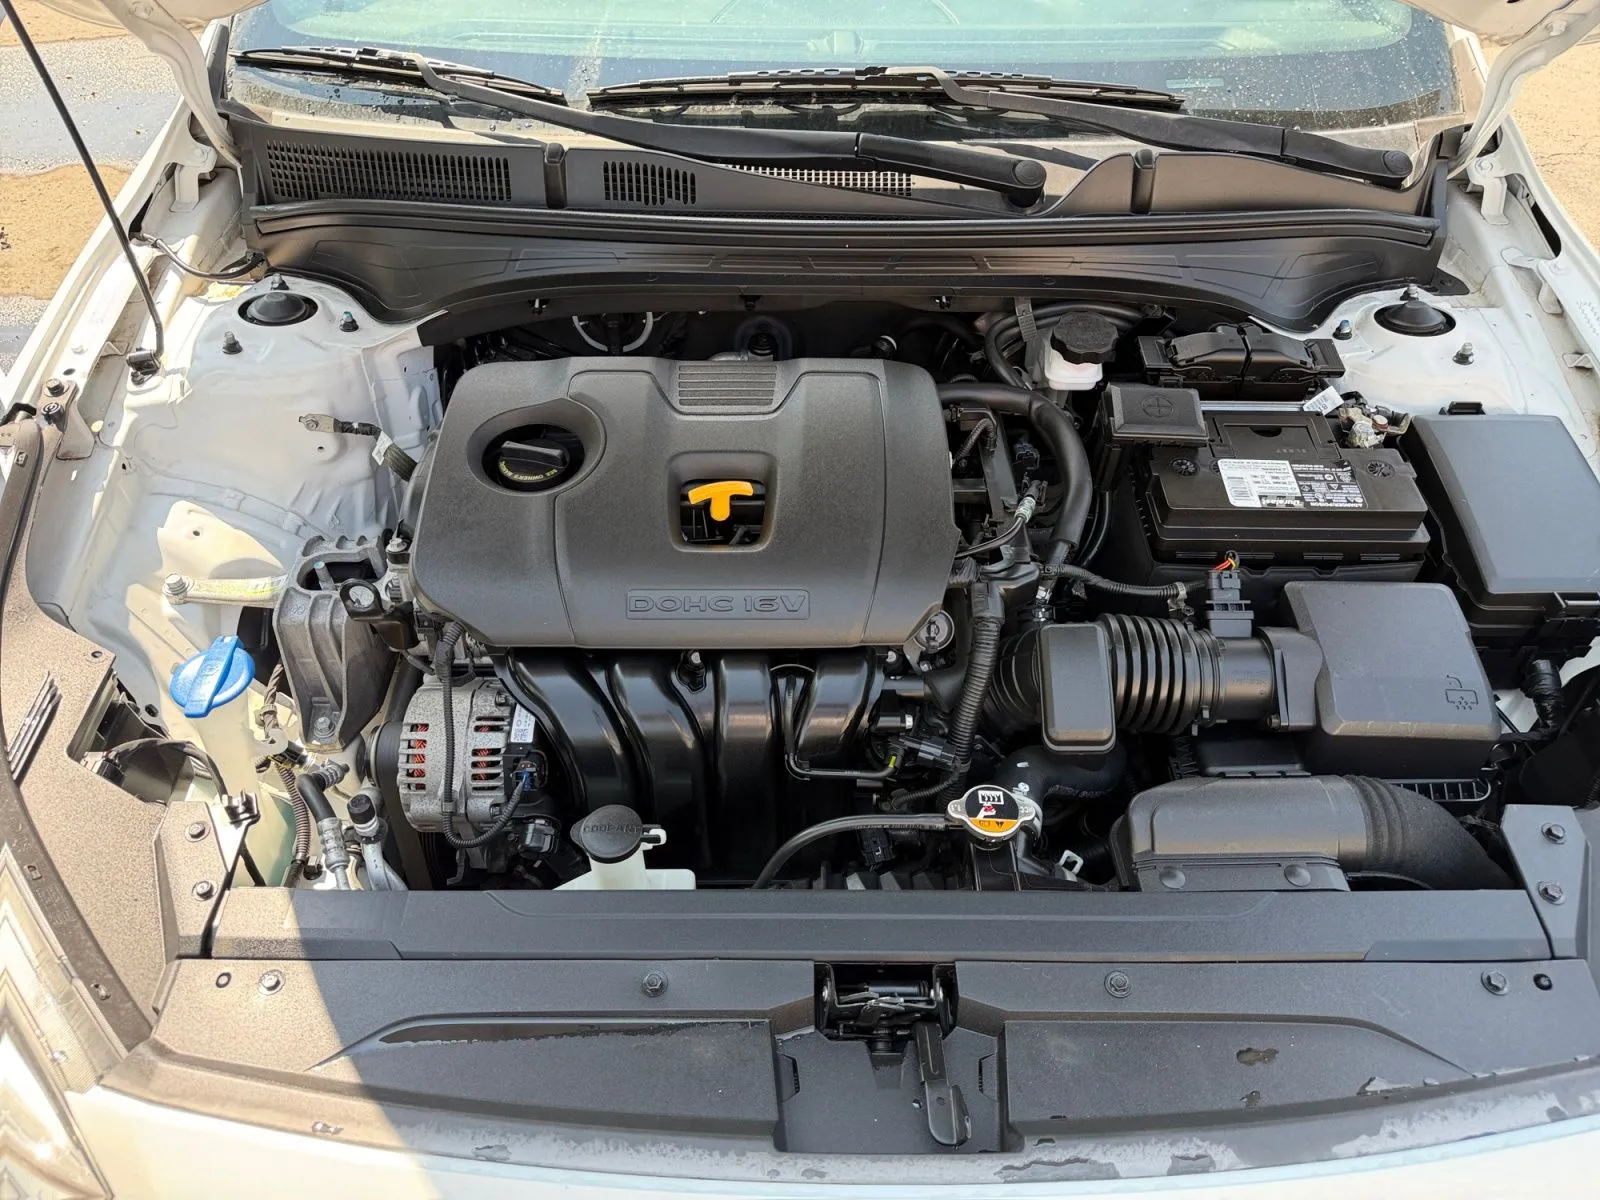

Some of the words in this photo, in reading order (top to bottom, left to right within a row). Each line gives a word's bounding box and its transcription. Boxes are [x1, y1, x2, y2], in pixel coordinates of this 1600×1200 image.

[1261, 499, 1300, 507] Duralast
[628, 595, 734, 612] DOHC
[743, 595, 806, 612] 16V
[583, 823, 641, 834] COOLANT
